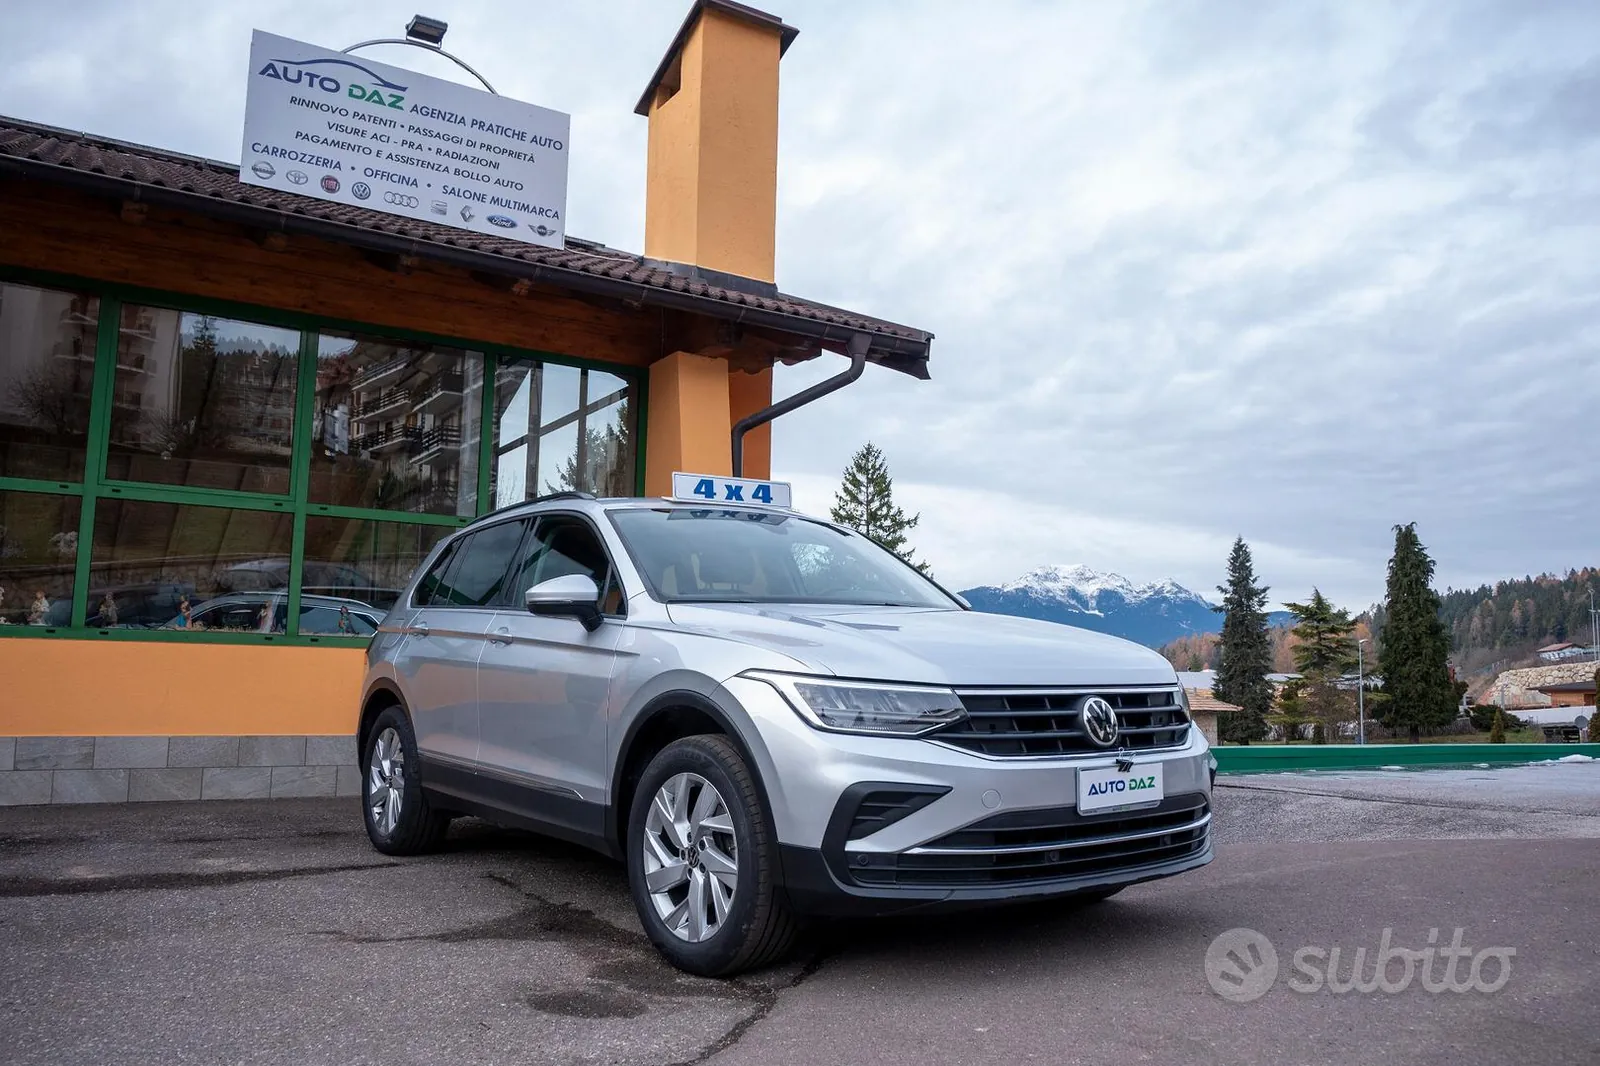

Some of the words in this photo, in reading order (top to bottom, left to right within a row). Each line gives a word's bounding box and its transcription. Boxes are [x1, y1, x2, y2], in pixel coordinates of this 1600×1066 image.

[258, 62, 341, 93] AUTO
[348, 83, 405, 111] DAZ
[289, 95, 349, 117] RINNOVO
[352, 111, 397, 129] PATENTI
[407, 124, 464, 145] PASSAGGI
[466, 139, 477, 149] DI
[479, 142, 535, 164] PROPRIETÀ
[327, 121, 368, 138] VISURE
[370, 132, 391, 144] ACI
[400, 139, 424, 152] PRA
[435, 147, 500, 170] RADIAZIONI
[410, 103, 467, 127] AGENZIA
[470, 118, 528, 142] PRATICHE
[530, 134, 563, 151] AUTO
[251, 142, 342, 171] CARROZZERIA
[363, 167, 419, 188] OFFICINA
[442, 184, 487, 204] SALONE
[489, 195, 560, 220] MULTIMARCA
[294, 130, 372, 156] PAGAMENTO
[375, 149, 384, 158] E
[385, 152, 450, 174] ASSISTENZA
[453, 169, 491, 184] BOLLO
[493, 177, 524, 192] AUTO
[693, 478, 717, 499] 4
[751, 484, 773, 504] 4
[1088, 779, 1126, 796] AUTO
[1128, 776, 1156, 791] DAZ
